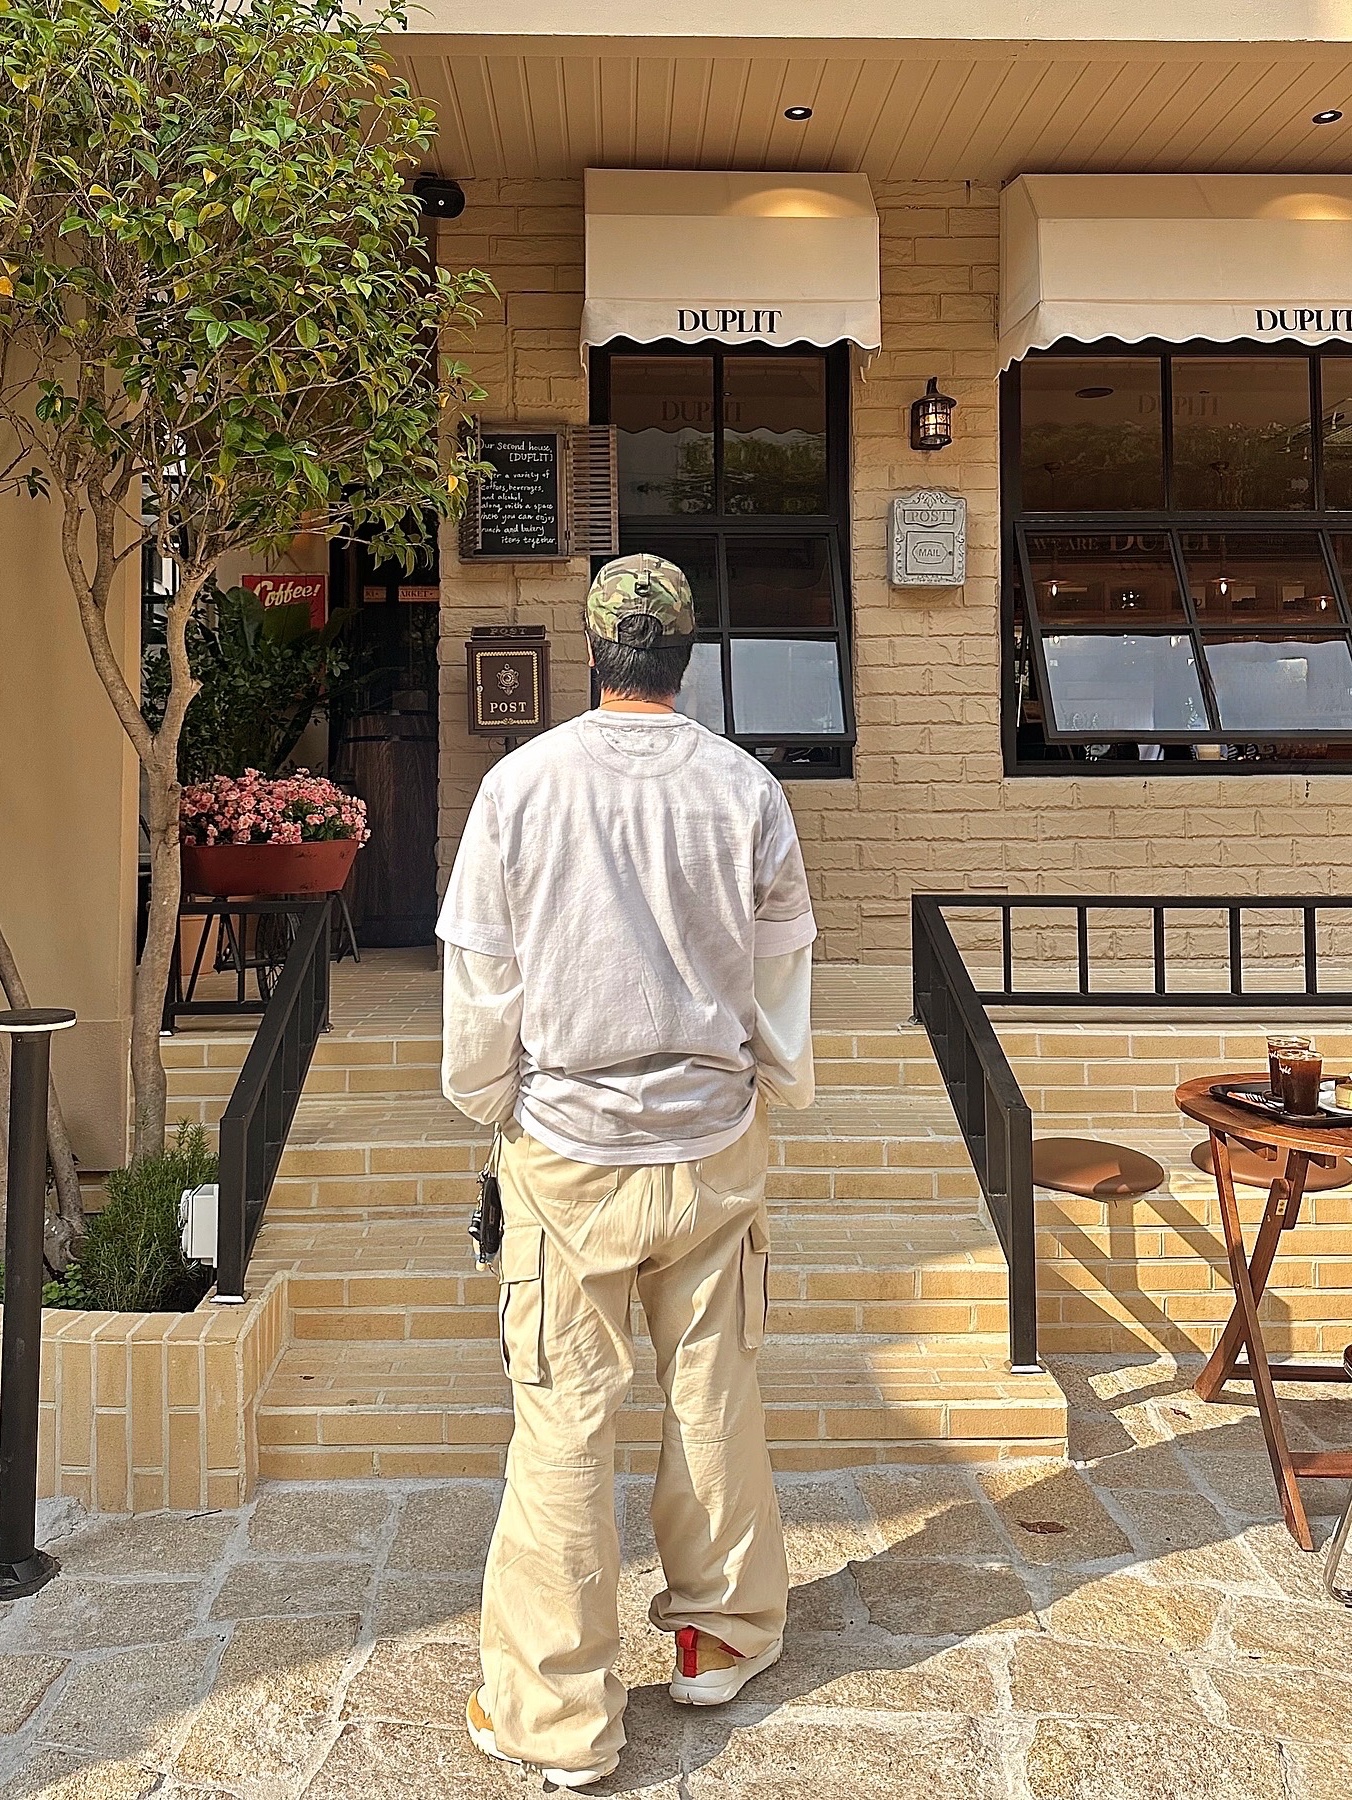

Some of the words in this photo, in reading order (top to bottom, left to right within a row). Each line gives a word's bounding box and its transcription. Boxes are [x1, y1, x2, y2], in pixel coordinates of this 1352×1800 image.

[677, 309, 783, 333] DUPLIT
[1254, 308, 1352, 331] DUPLIT
[1138, 393, 1221, 416] DPLIT
[661, 400, 746, 423] DUPIT
[513, 471, 540, 482] variety
[541, 469, 550, 479] of
[480, 501, 503, 513] along
[504, 502, 523, 510] with
[533, 503, 553, 513] space
[501, 514, 516, 525] you
[535, 512, 555, 524] enjoy
[910, 511, 949, 521] POST
[503, 524, 519, 534] and
[520, 524, 545, 537] bakery
[1066, 537, 1099, 550] ARE
[918, 548, 941, 557] MAIL
[253, 580, 321, 611] Coffee!
[489, 627, 527, 635] POST
[489, 701, 527, 713] POST
